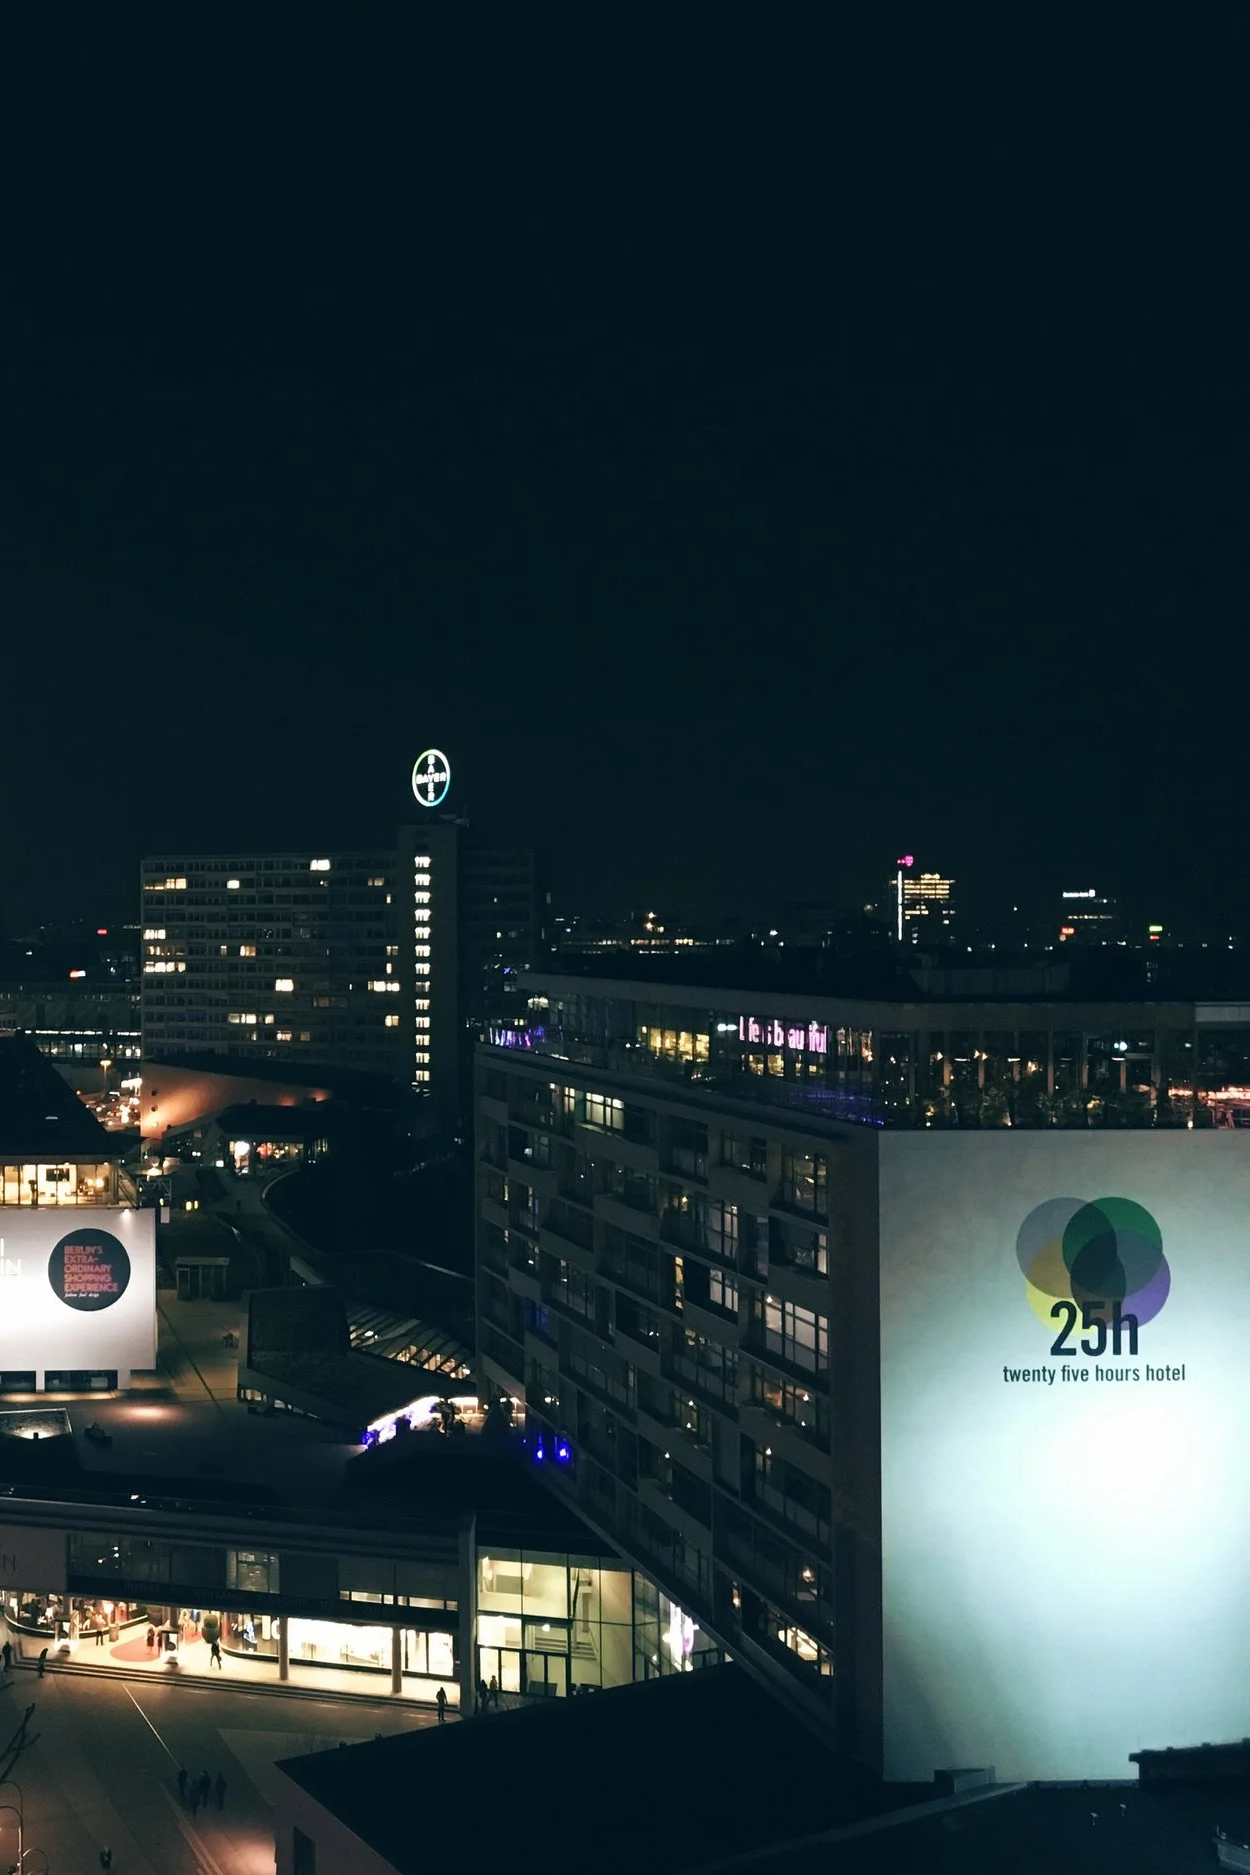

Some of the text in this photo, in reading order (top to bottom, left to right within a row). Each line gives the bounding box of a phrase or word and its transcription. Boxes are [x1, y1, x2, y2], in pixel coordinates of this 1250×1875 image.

[64, 1245, 102, 1254] BERLIN'S
[64, 1255, 99, 1264] EXTRA-
[64, 1264, 111, 1273] ORDINARY
[64, 1273, 111, 1282] SHOPPING
[64, 1283, 118, 1292] EXPERIENCE
[1050, 1301, 1138, 1356] 25h
[1003, 1364, 1186, 1385] twenty five hours hotel
